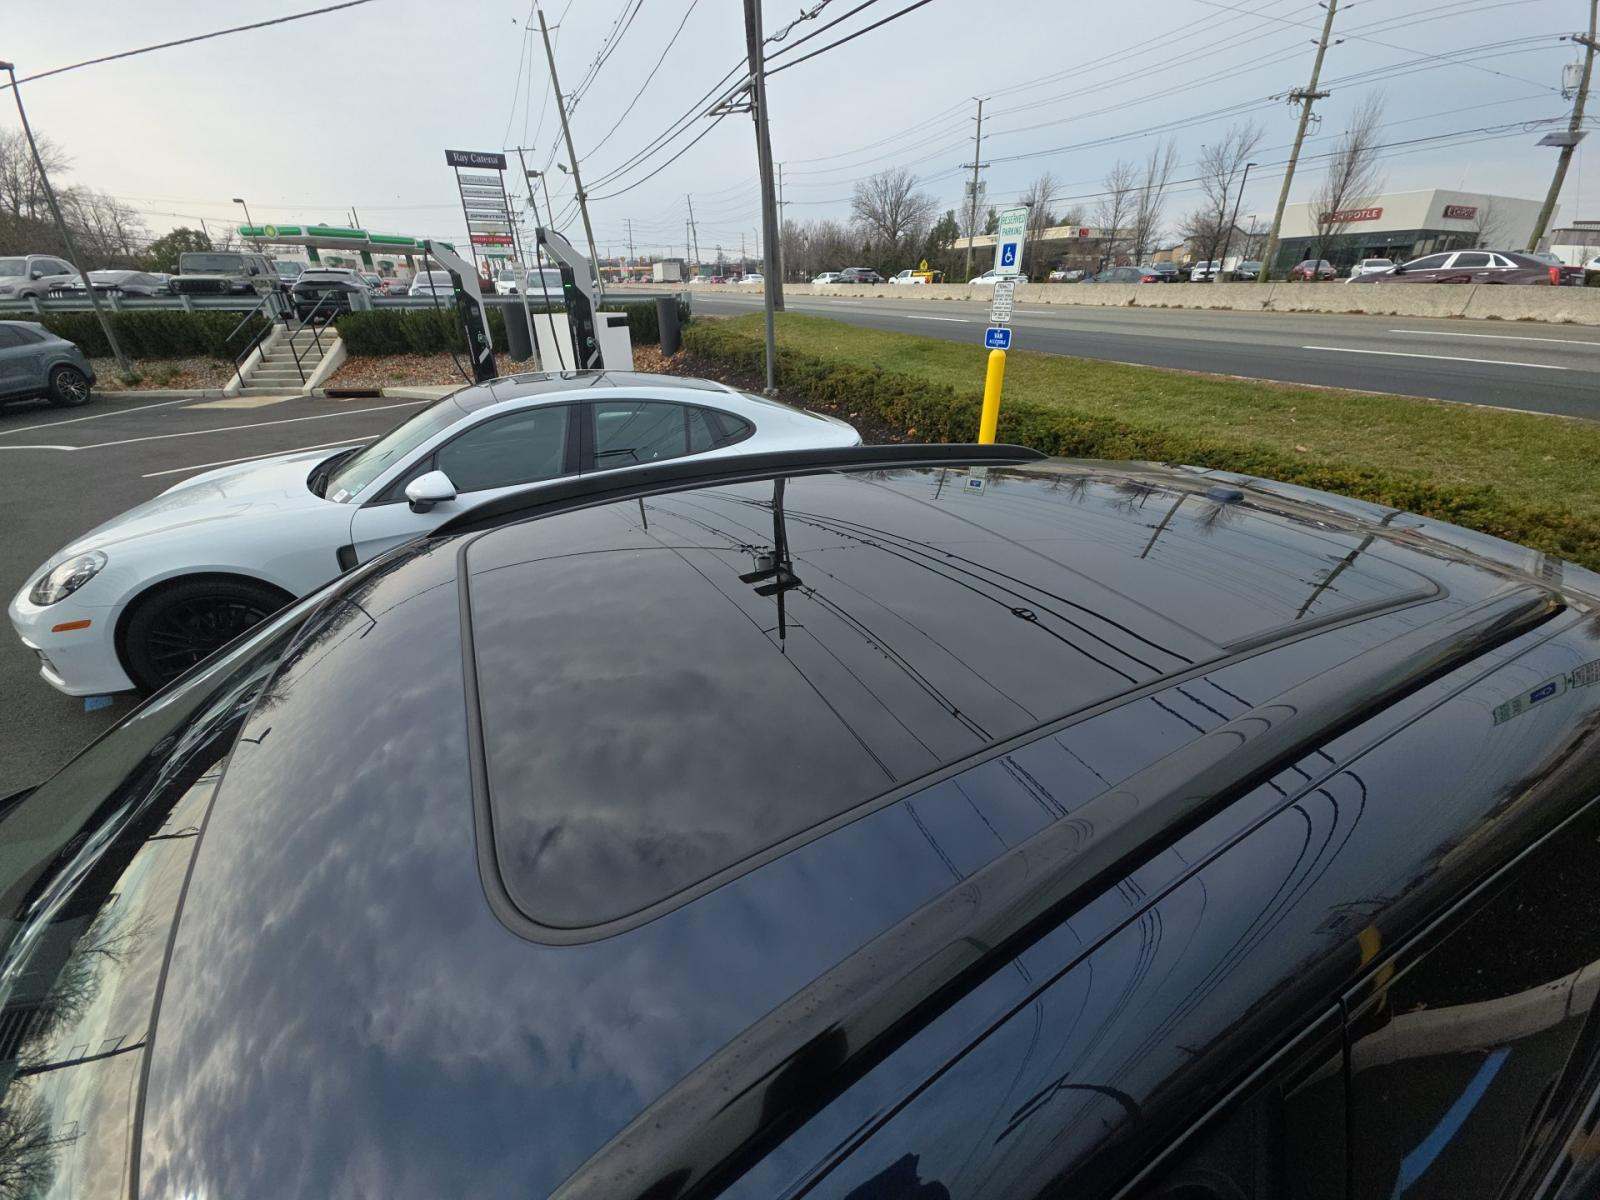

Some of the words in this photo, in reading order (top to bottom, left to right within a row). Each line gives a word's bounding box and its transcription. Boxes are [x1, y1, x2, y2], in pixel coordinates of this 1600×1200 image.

[453, 152, 468, 163] Ray
[470, 153, 498, 164] Catena
[1000, 213, 1025, 223] RESERVED
[1002, 226, 1022, 235] PARKING
